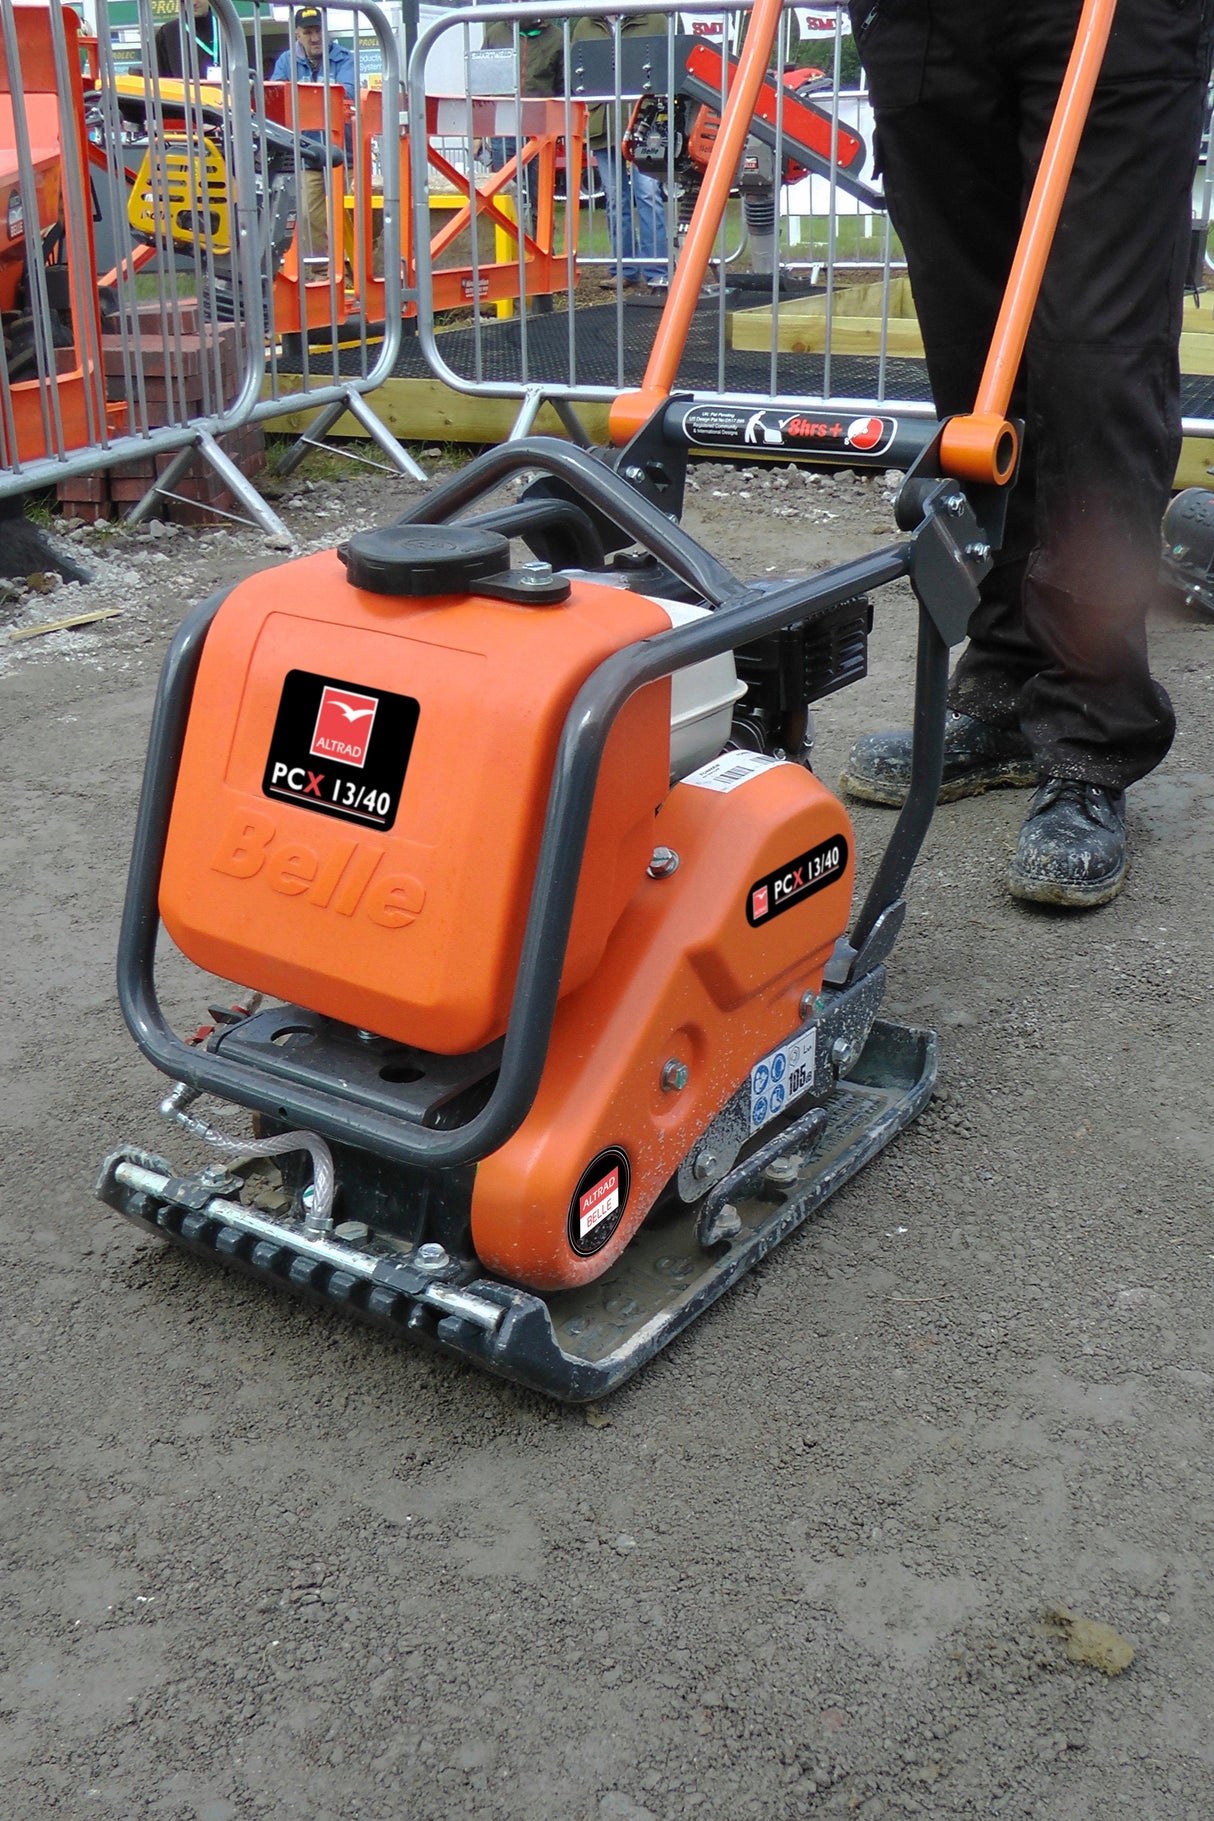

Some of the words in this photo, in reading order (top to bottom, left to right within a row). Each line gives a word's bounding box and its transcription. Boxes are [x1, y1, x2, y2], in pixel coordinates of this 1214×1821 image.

[788, 417, 828, 438] 8hrs
[316, 737, 362, 758] ALTRAD
[272, 762, 325, 797] PCX
[332, 779, 391, 815] 13/40
[210, 806, 427, 930] Belle
[774, 867, 803, 900] PCX
[808, 846, 839, 880] 13/40
[583, 1176, 615, 1211] ALTRAD
[587, 1198, 612, 1228] BELLE
